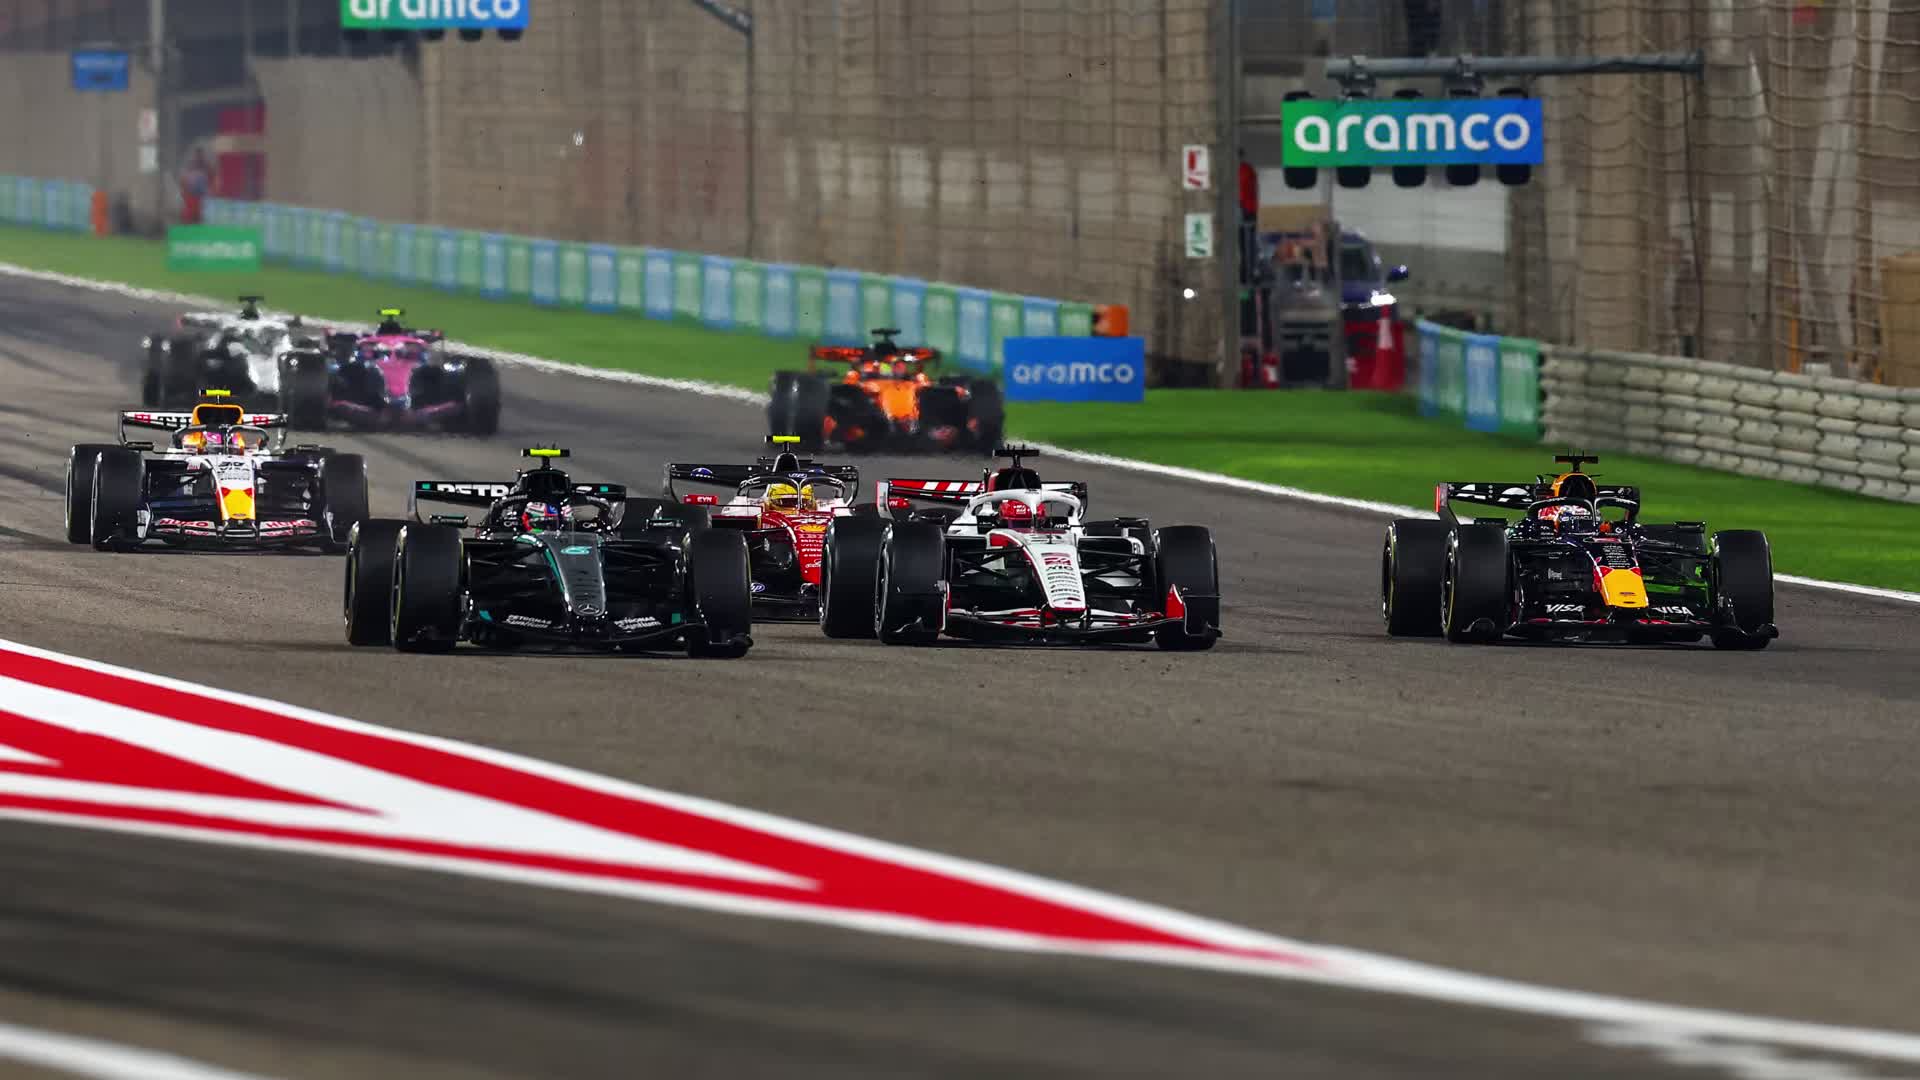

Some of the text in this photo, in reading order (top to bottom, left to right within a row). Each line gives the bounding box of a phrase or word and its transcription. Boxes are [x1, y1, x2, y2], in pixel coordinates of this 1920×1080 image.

[349, 0, 521, 20] aramco
[1294, 103, 1531, 152] aramco
[1013, 361, 1134, 384] aramco
[1545, 604, 1587, 613] VISA
[1651, 606, 1694, 616] VISA
